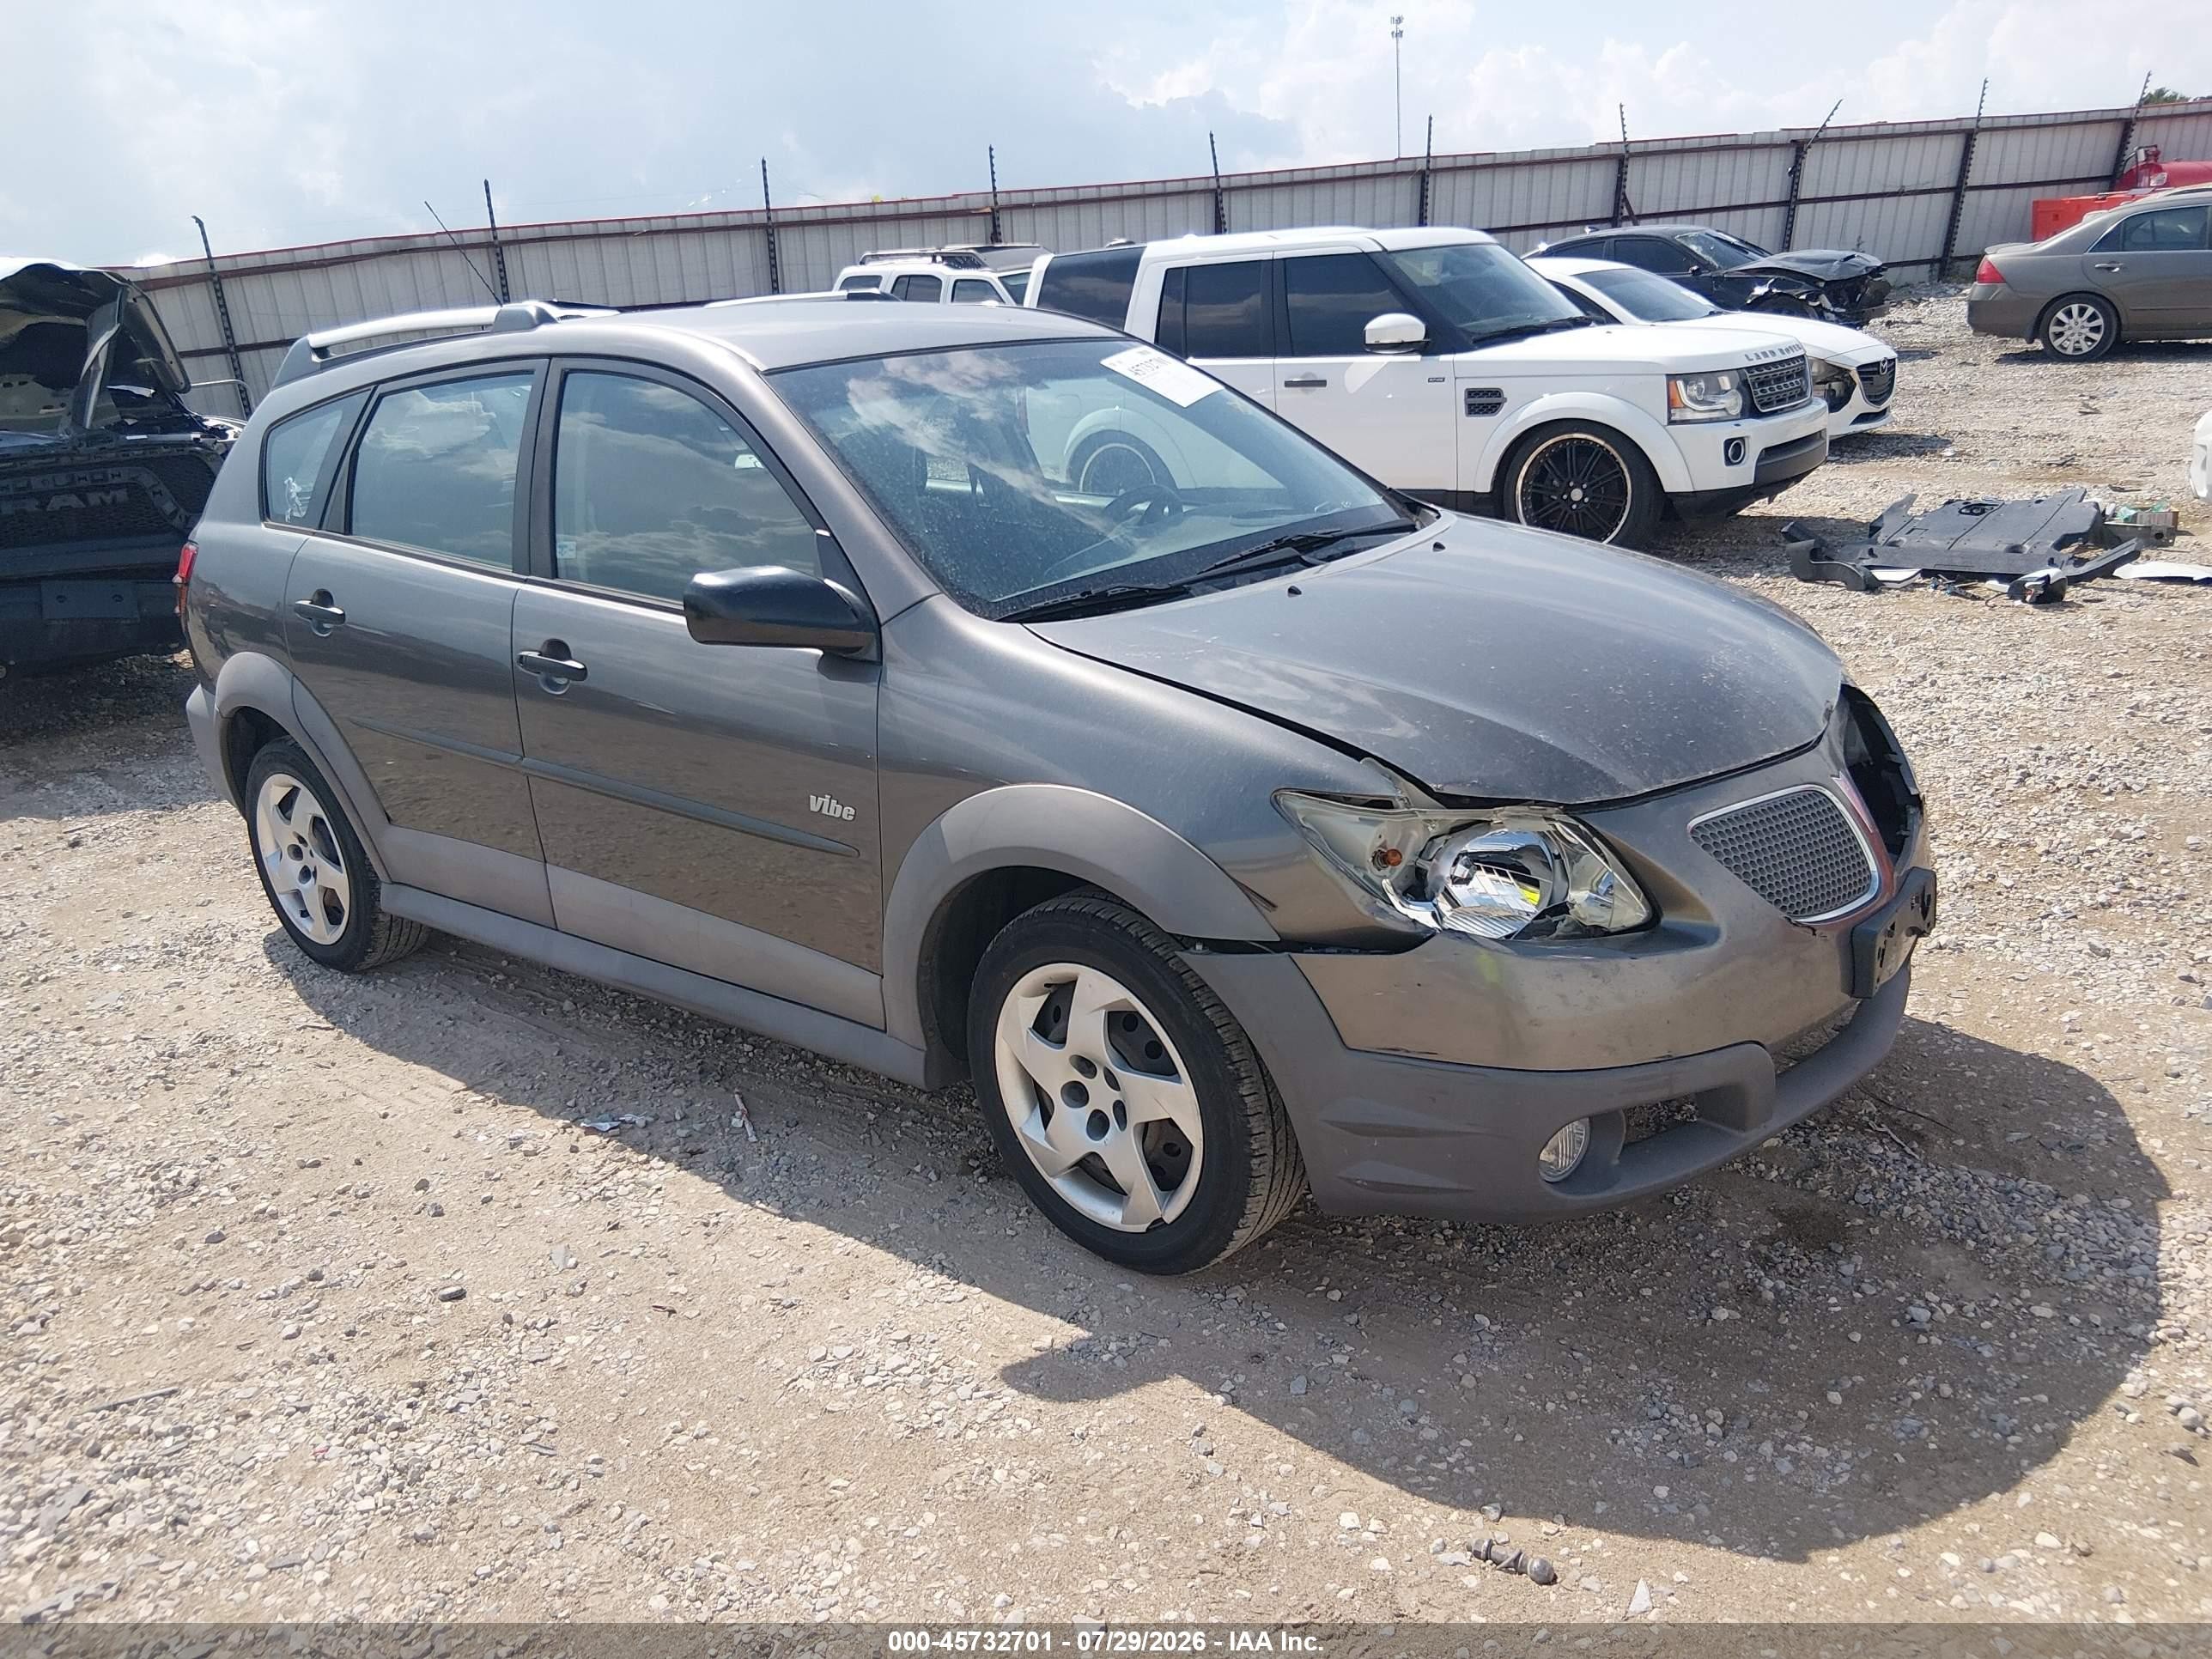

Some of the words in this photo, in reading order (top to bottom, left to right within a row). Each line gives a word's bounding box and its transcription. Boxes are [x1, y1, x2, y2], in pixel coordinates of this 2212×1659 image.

[1744, 349, 1777, 362] LAND
[1778, 343, 1802, 356] ROVER
[810, 794, 856, 821] vibe
